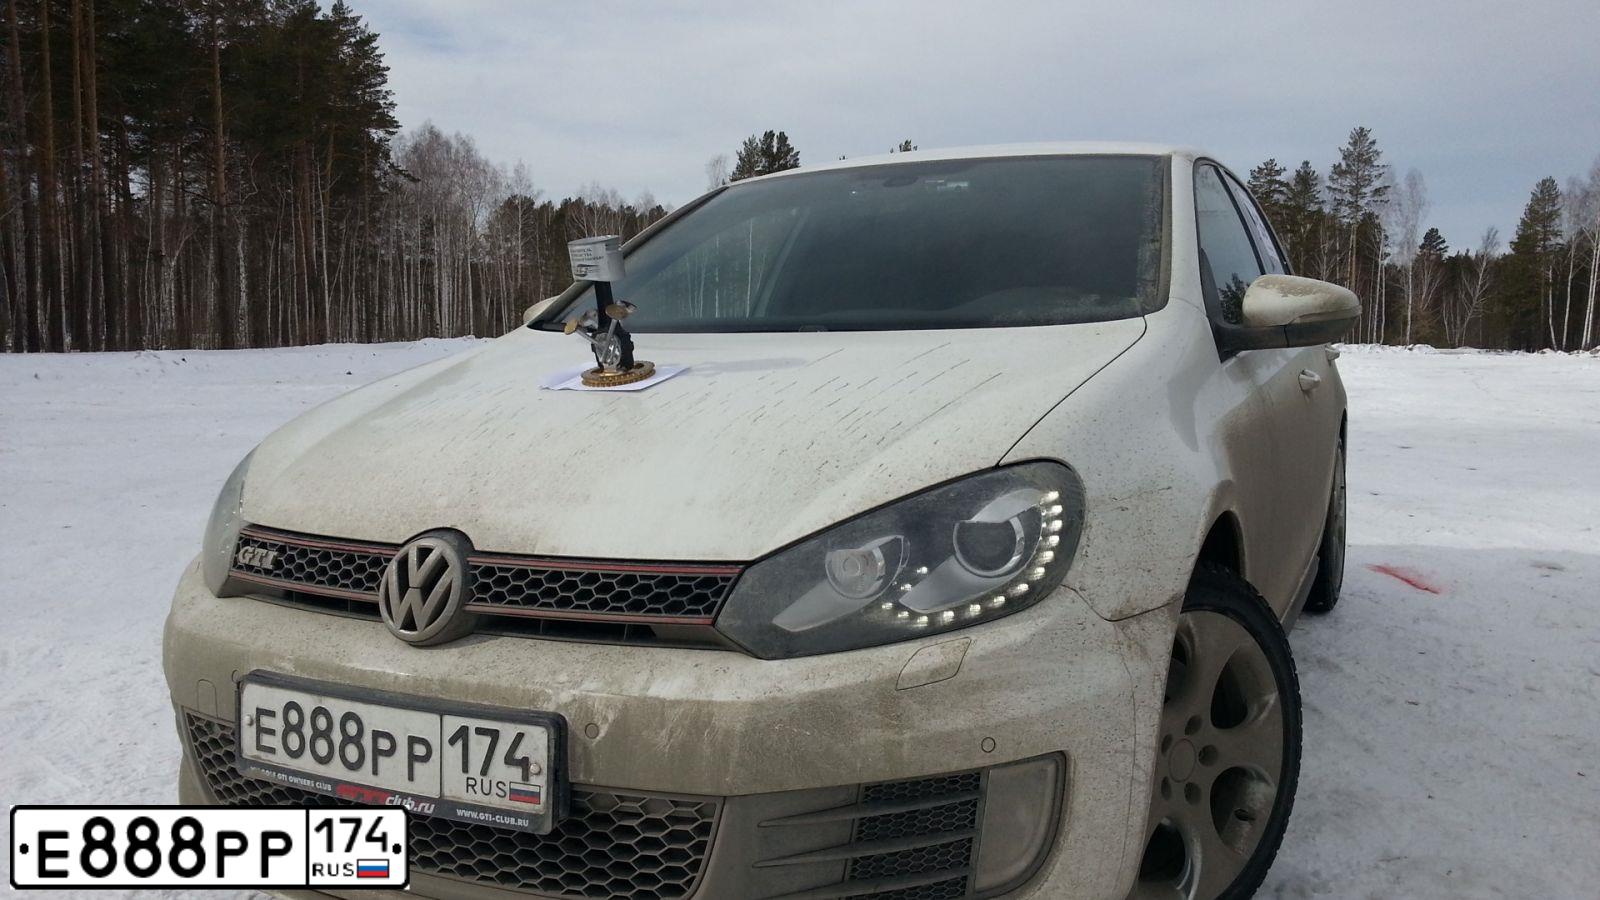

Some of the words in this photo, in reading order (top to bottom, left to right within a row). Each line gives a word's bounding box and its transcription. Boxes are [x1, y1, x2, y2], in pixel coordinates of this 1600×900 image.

[238, 546, 278, 570] GTI
[255, 700, 432, 782] E888PP
[448, 725, 529, 782] 174
[277, 773, 288, 781] GTI
[288, 776, 315, 788] OWNERS
[315, 781, 332, 792] CLUB
[466, 777, 507, 798] RUS
[385, 794, 435, 814] club.ru
[456, 808, 529, 828] WWW.GTI-CLUB.RU
